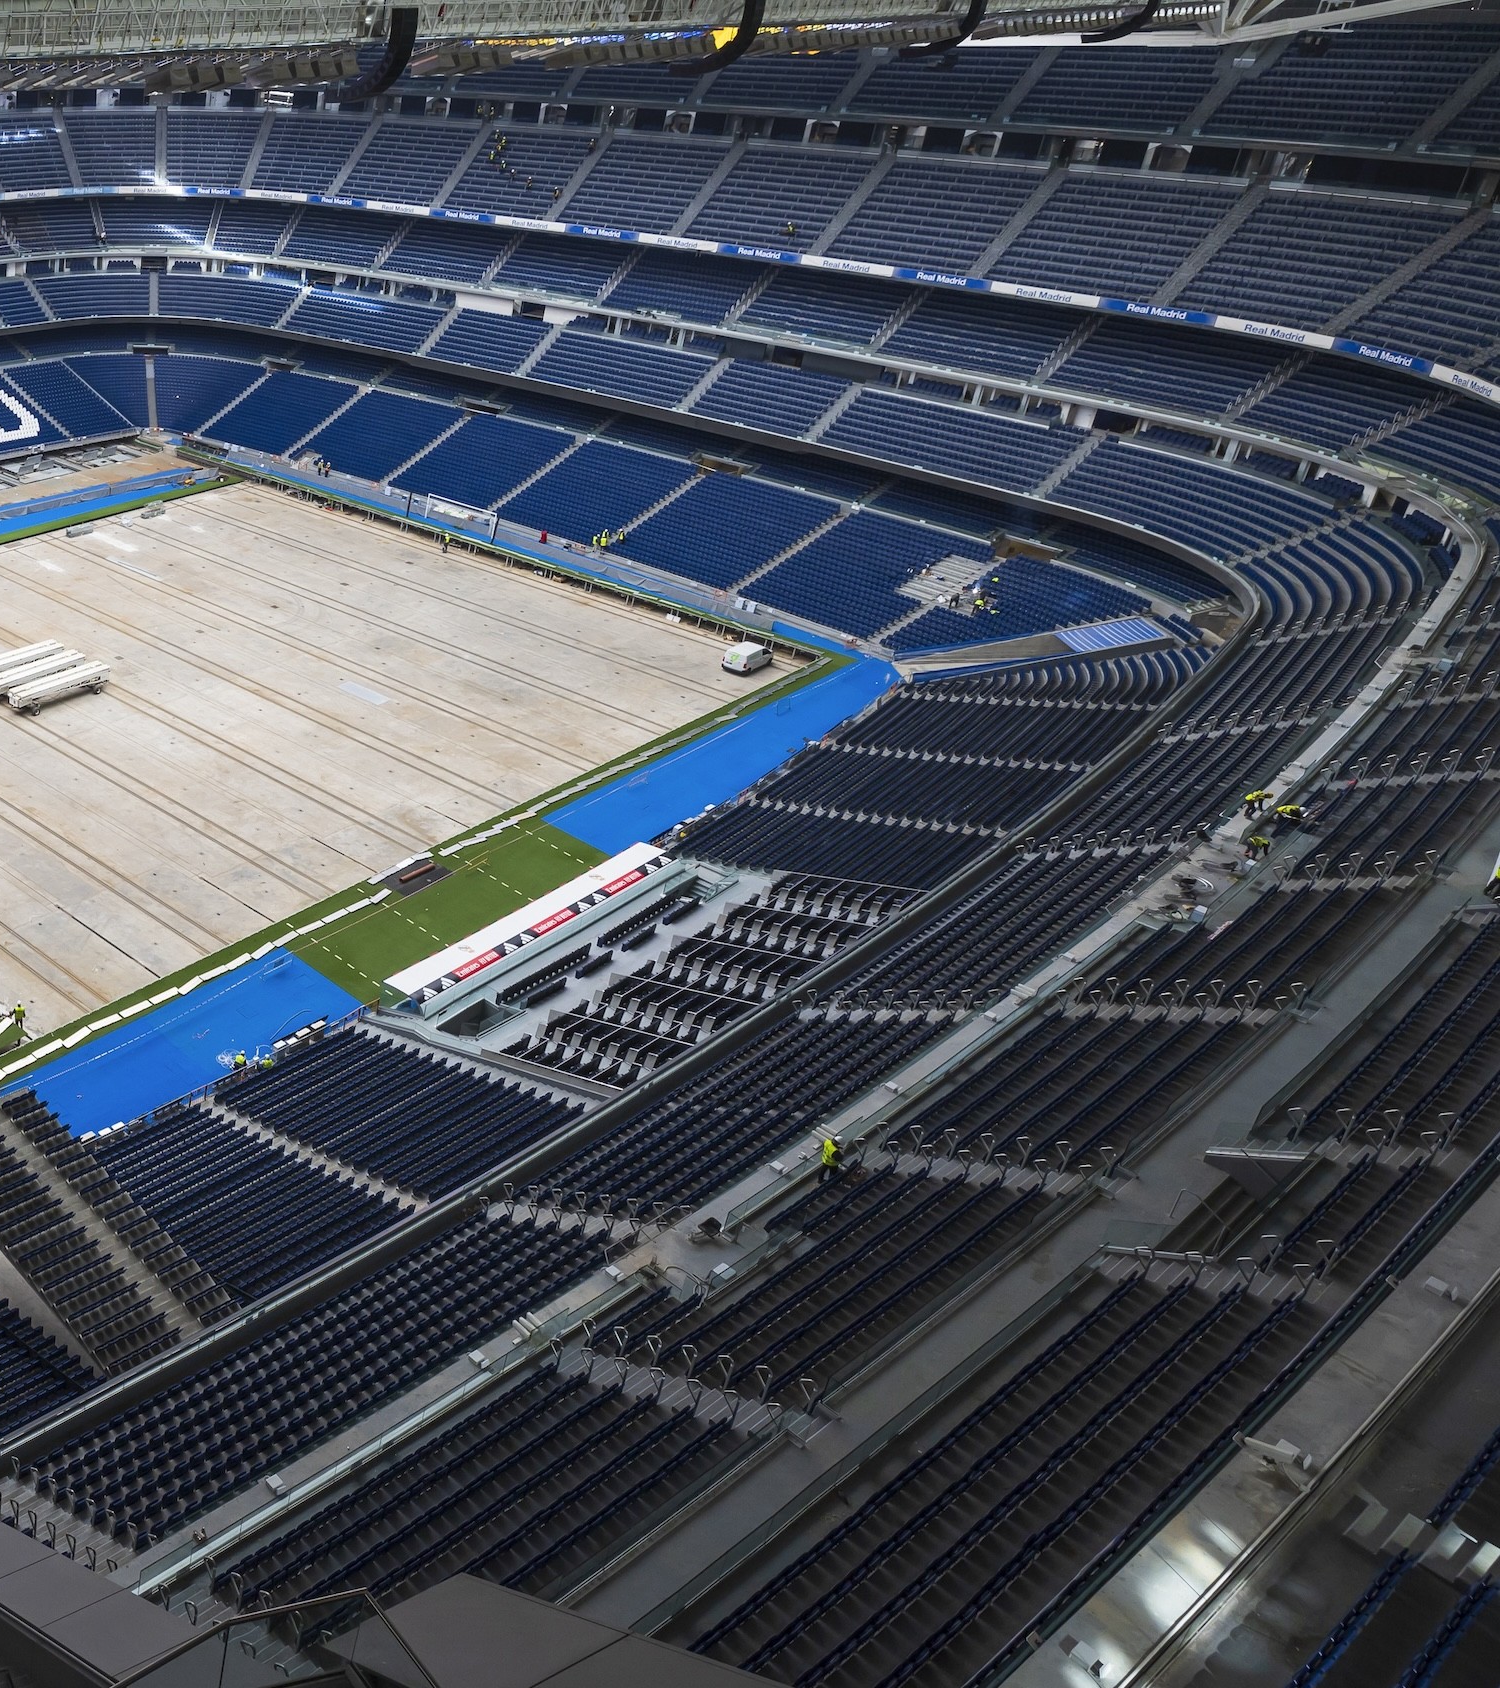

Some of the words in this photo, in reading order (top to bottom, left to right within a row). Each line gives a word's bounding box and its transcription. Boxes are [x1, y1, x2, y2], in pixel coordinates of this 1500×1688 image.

[272, 192, 292, 200] Madrid
[334, 198, 352, 206] Madrid
[397, 205, 414, 213] Madrid
[459, 212, 479, 221] Madrid
[526, 221, 548, 230] Madrid
[583, 227, 597, 235] Real
[598, 229, 621, 238] Madrid
[674, 239, 698, 248] Madrid
[738, 247, 754, 256] Real
[755, 249, 780, 260] Madrid
[822, 260, 840, 269] Real
[841, 263, 870, 273] Madrid
[916, 272, 935, 282] Real
[936, 274, 966, 286] Madrid
[1016, 288, 1036, 297] Real
[1038, 290, 1071, 303] Madrid
[1127, 303, 1149, 314] Real
[1151, 306, 1186, 320] Madrid
[1244, 324, 1268, 335] Real
[1270, 328, 1305, 342] Madrid
[1358, 346, 1378, 359] Real
[1379, 350, 1412, 368] Madrid
[1452, 374, 1469, 387] Real
[1469, 378, 1492, 396] Madrid
[604, 880, 627, 893] Emirates
[534, 920, 557, 933] Emirates
[455, 962, 480, 977] Emirates
